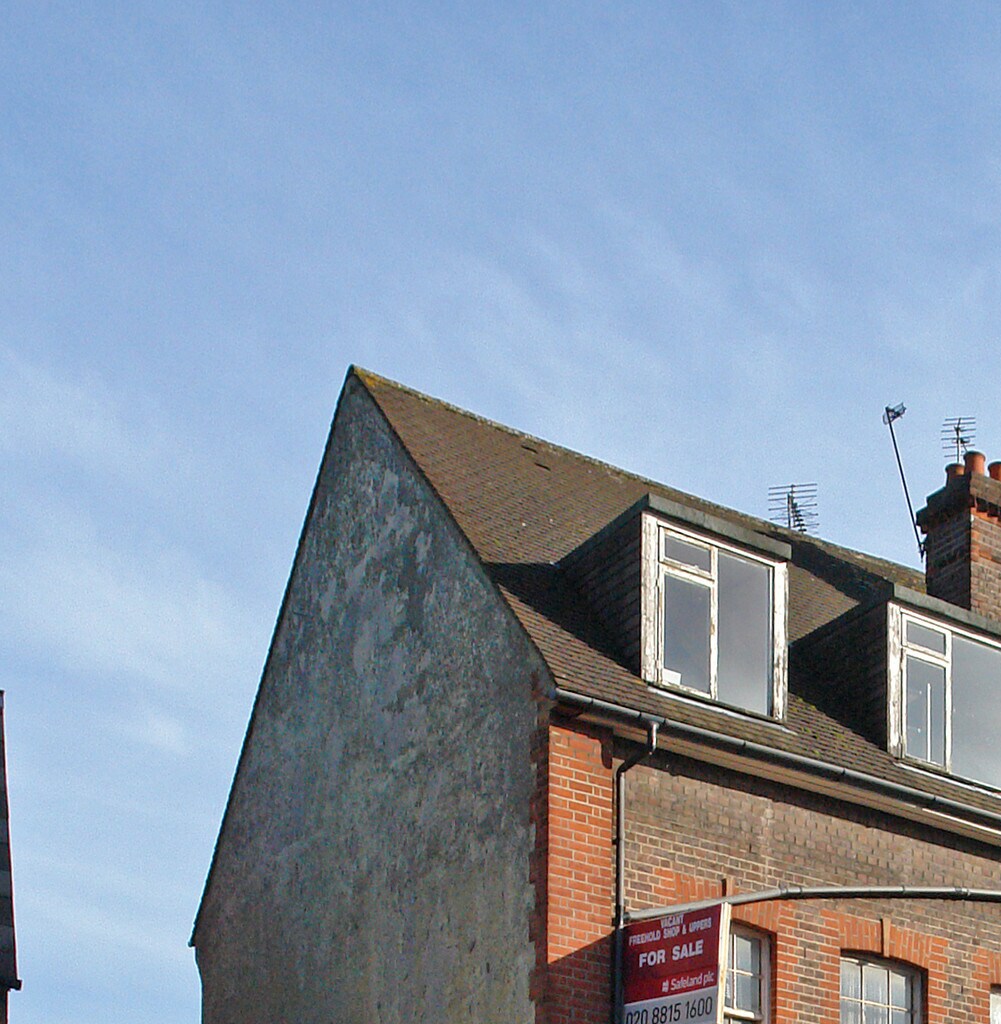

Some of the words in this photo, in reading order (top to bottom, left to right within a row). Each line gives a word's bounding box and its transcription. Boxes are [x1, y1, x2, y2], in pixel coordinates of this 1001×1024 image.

[629, 930, 661, 946] FREEHOLD
[663, 926, 680, 939] SHOP
[682, 924, 687, 935] &
[689, 917, 712, 933] UPPERS
[661, 914, 684, 928] VACANT
[639, 949, 666, 968] FOR
[672, 939, 704, 961] SALE
[670, 973, 702, 991] Safeland
[703, 971, 714, 986] plc
[686, 996, 713, 1019] 1600
